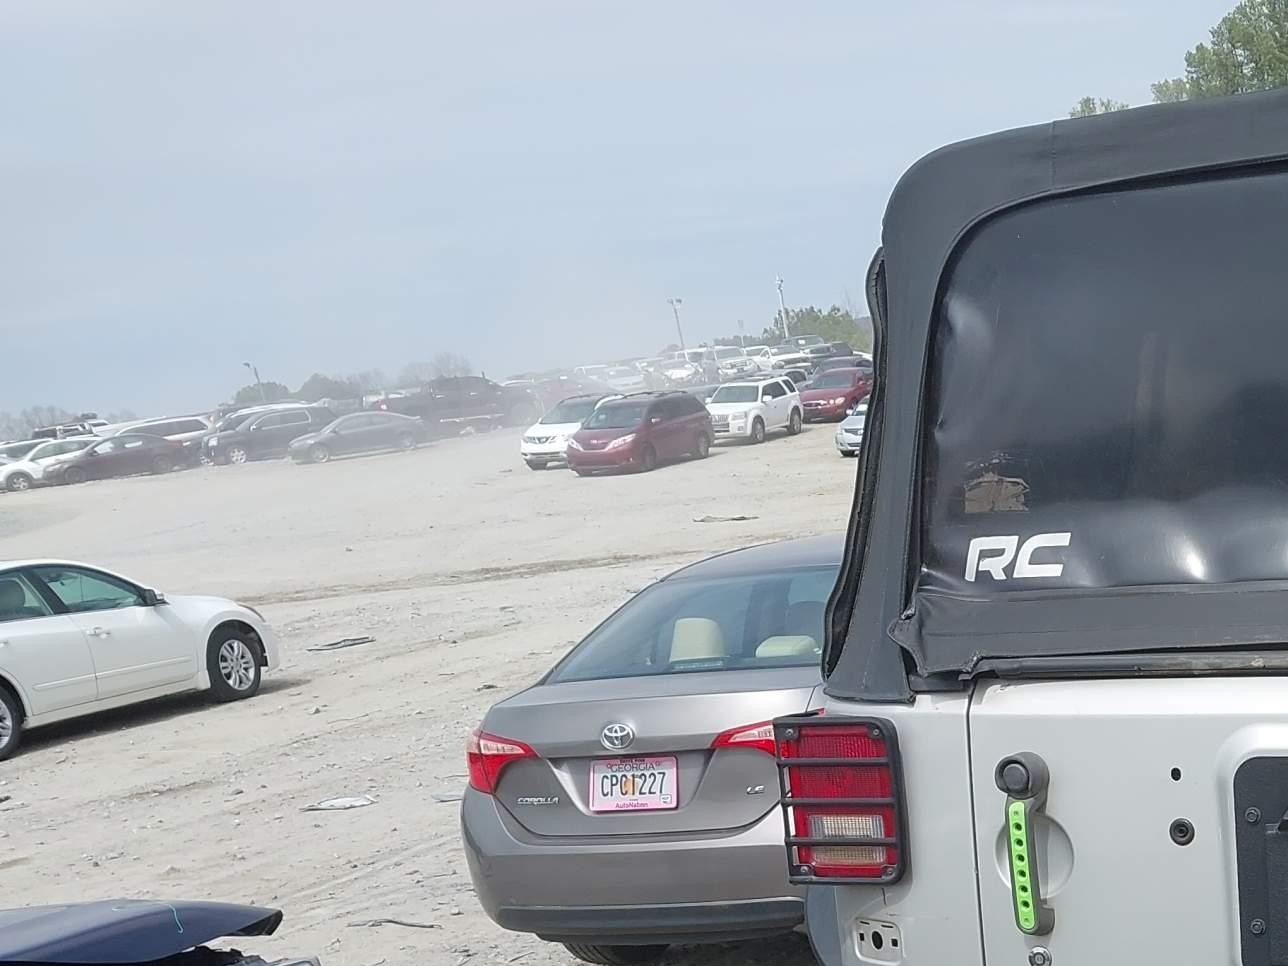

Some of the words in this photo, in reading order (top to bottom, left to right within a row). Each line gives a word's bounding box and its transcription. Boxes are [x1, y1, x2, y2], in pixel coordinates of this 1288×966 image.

[964, 532, 1072, 582] RC
[609, 762, 656, 773] GEORGIA
[517, 796, 559, 805] COROLLA
